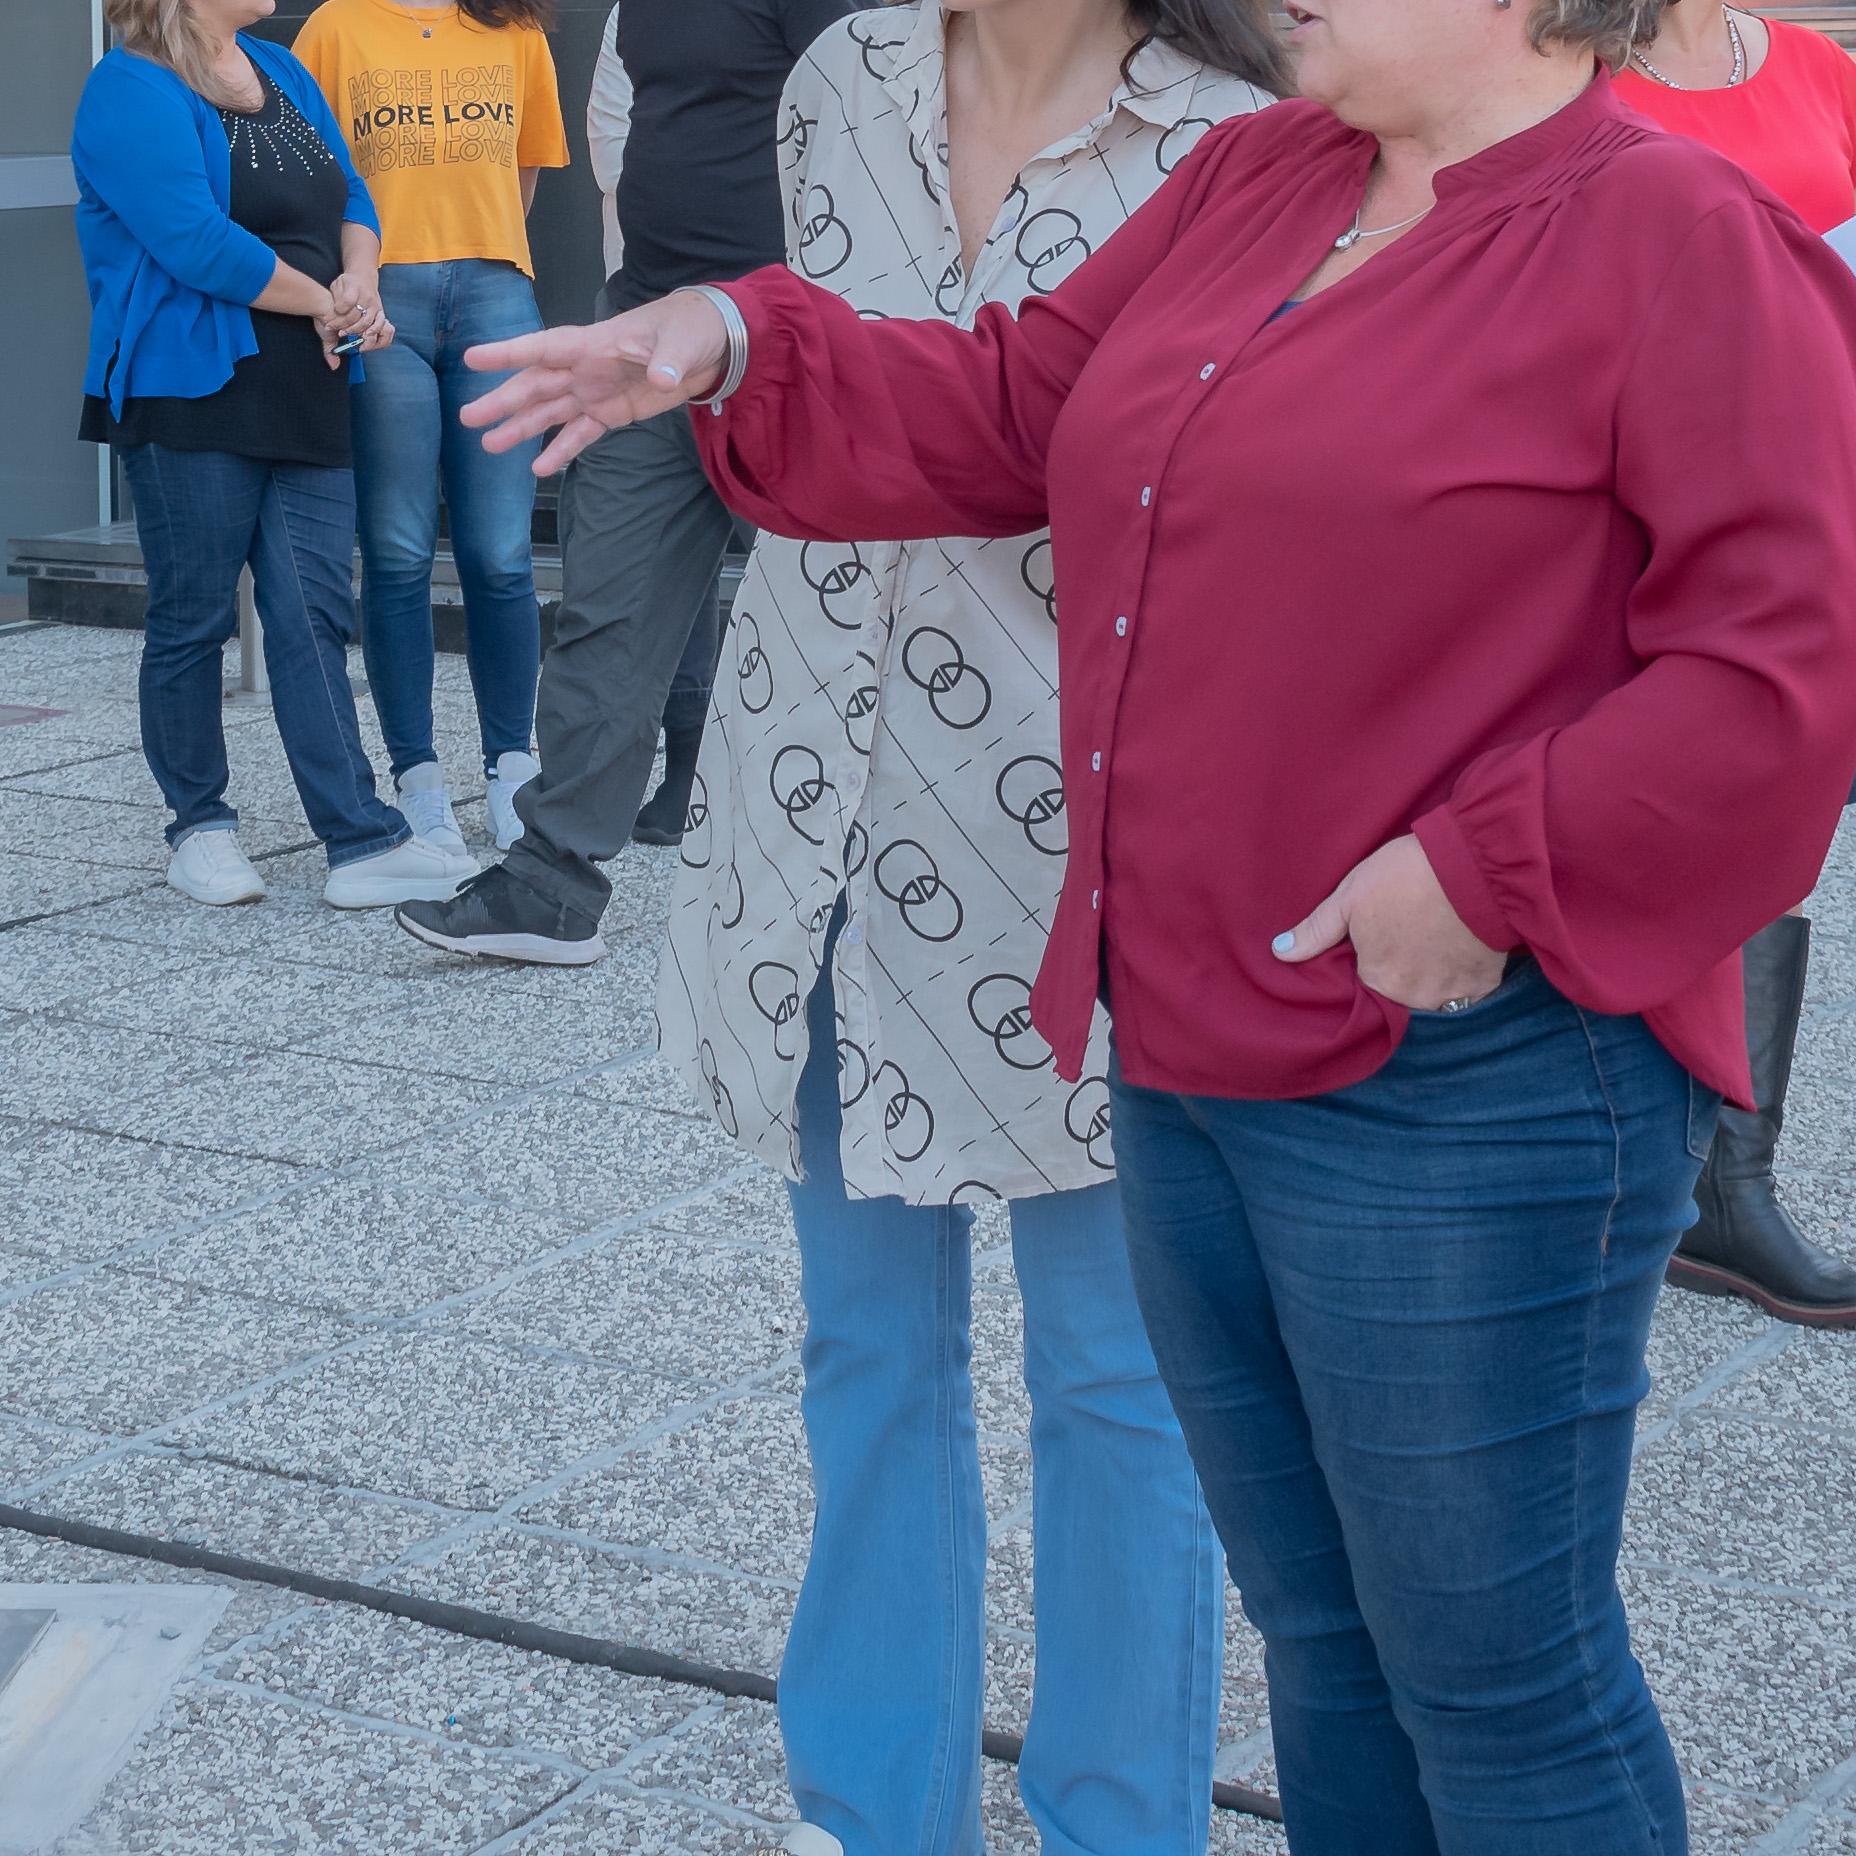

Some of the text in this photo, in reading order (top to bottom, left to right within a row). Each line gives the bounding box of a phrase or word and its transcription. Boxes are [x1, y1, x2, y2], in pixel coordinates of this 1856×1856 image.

[348, 65, 513, 100] MORE LOVE
[353, 102, 514, 141] MORE LOVE
[359, 139, 512, 179] MORE LOVE
